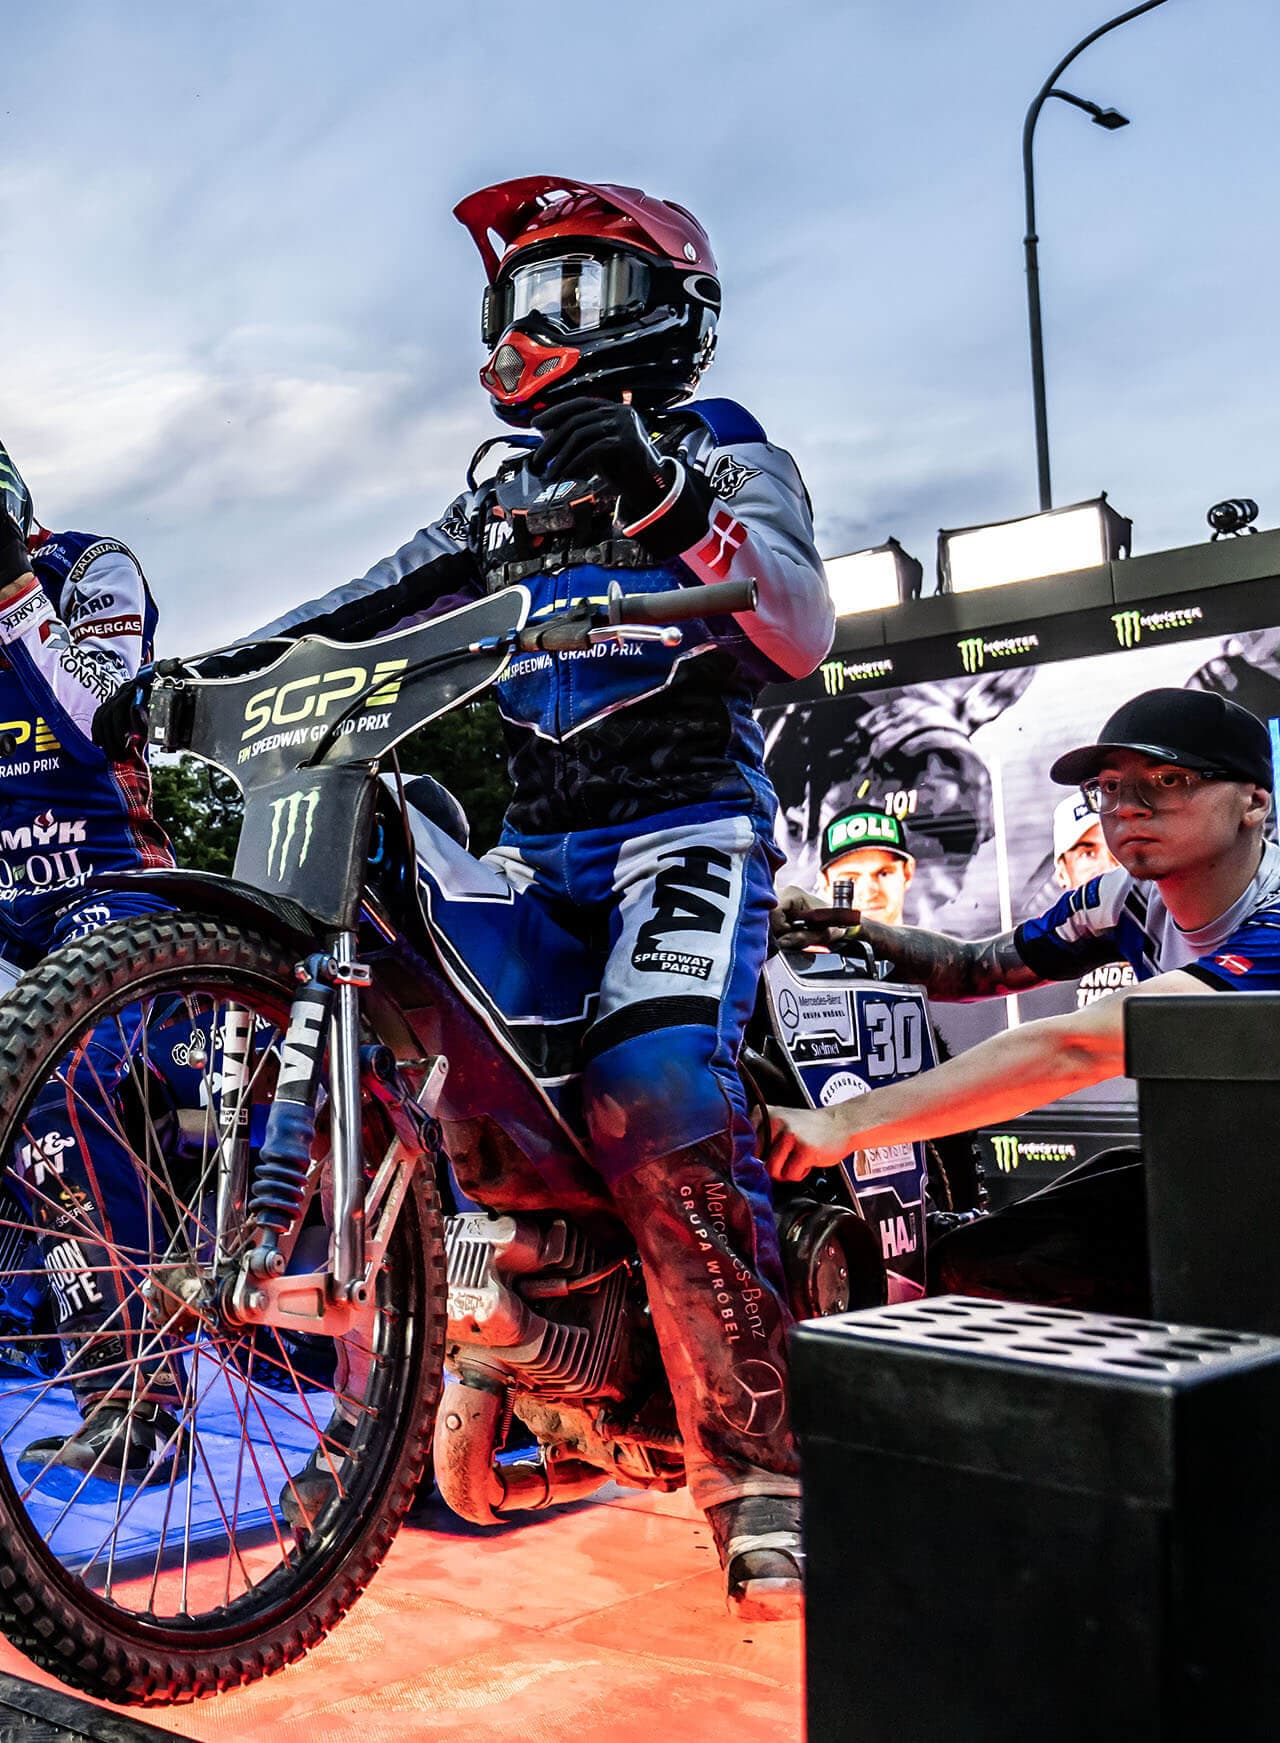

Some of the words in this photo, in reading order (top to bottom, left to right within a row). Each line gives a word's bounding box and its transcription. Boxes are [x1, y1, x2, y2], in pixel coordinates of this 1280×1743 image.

[510, 655, 552, 679] SPEEDWA
[250, 728, 309, 759] SPEEDWAY
[357, 712, 391, 734] PRIX
[33, 757, 60, 773] PRIX
[884, 789, 917, 815] 101
[633, 952, 712, 968] SPEEDWAY
[661, 961, 708, 978] PARTS
[863, 999, 923, 1079] 30
[680, 1185, 713, 1252] GRUPA
[706, 1260, 741, 1345] WRÓBEL
